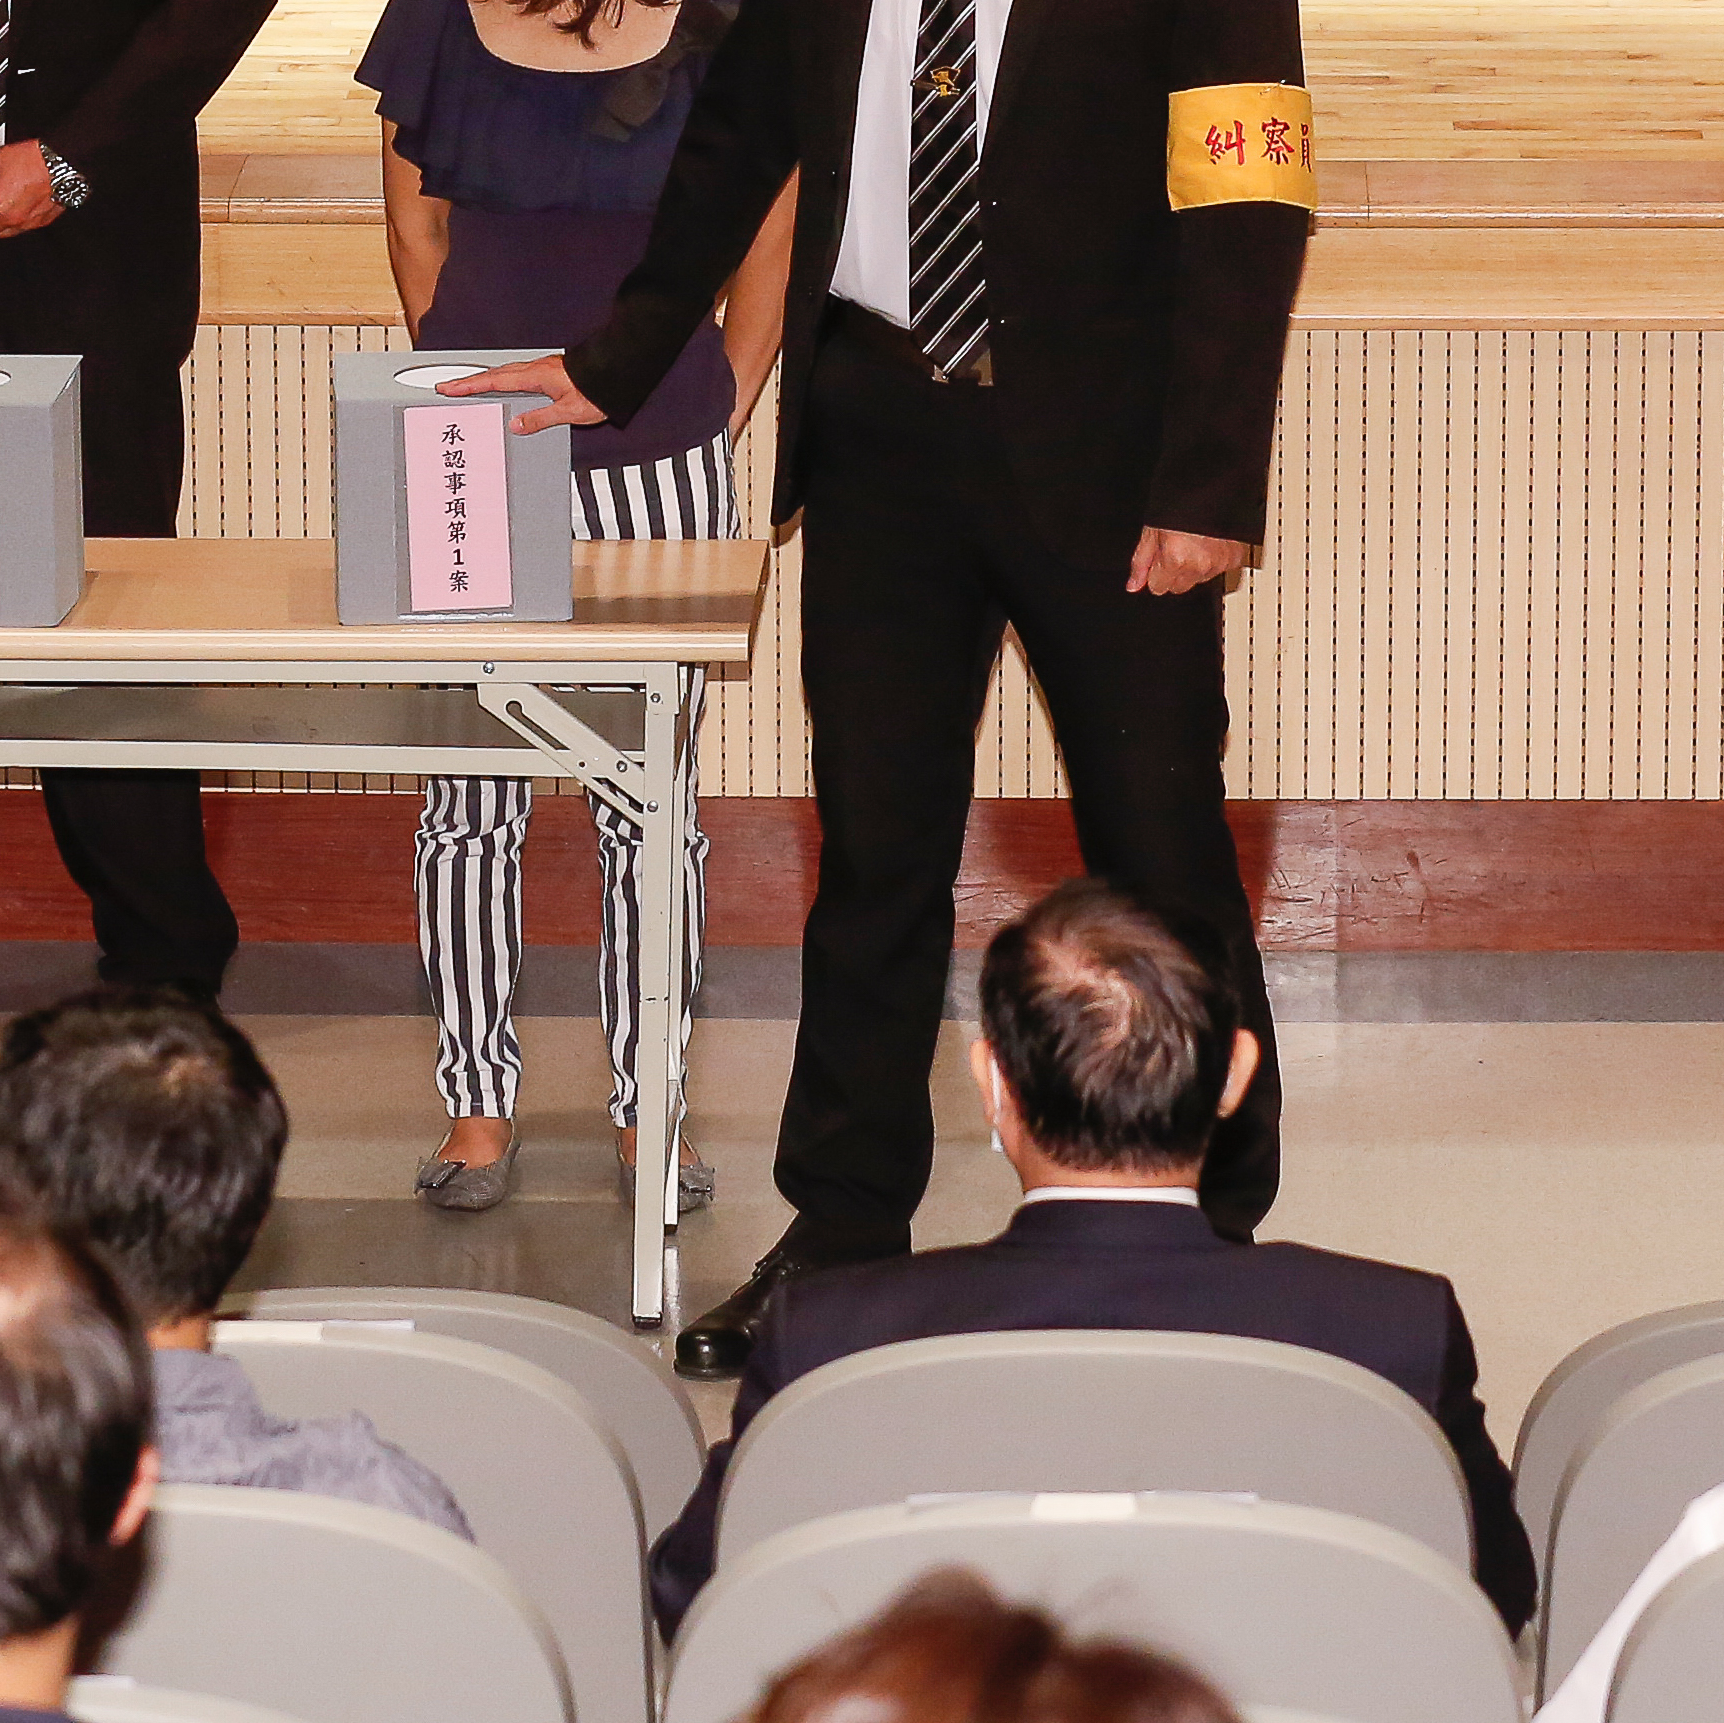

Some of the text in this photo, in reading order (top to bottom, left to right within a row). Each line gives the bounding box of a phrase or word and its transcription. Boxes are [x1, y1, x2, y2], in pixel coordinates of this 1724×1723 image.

[441, 423, 470, 593] 承認事項第1案
